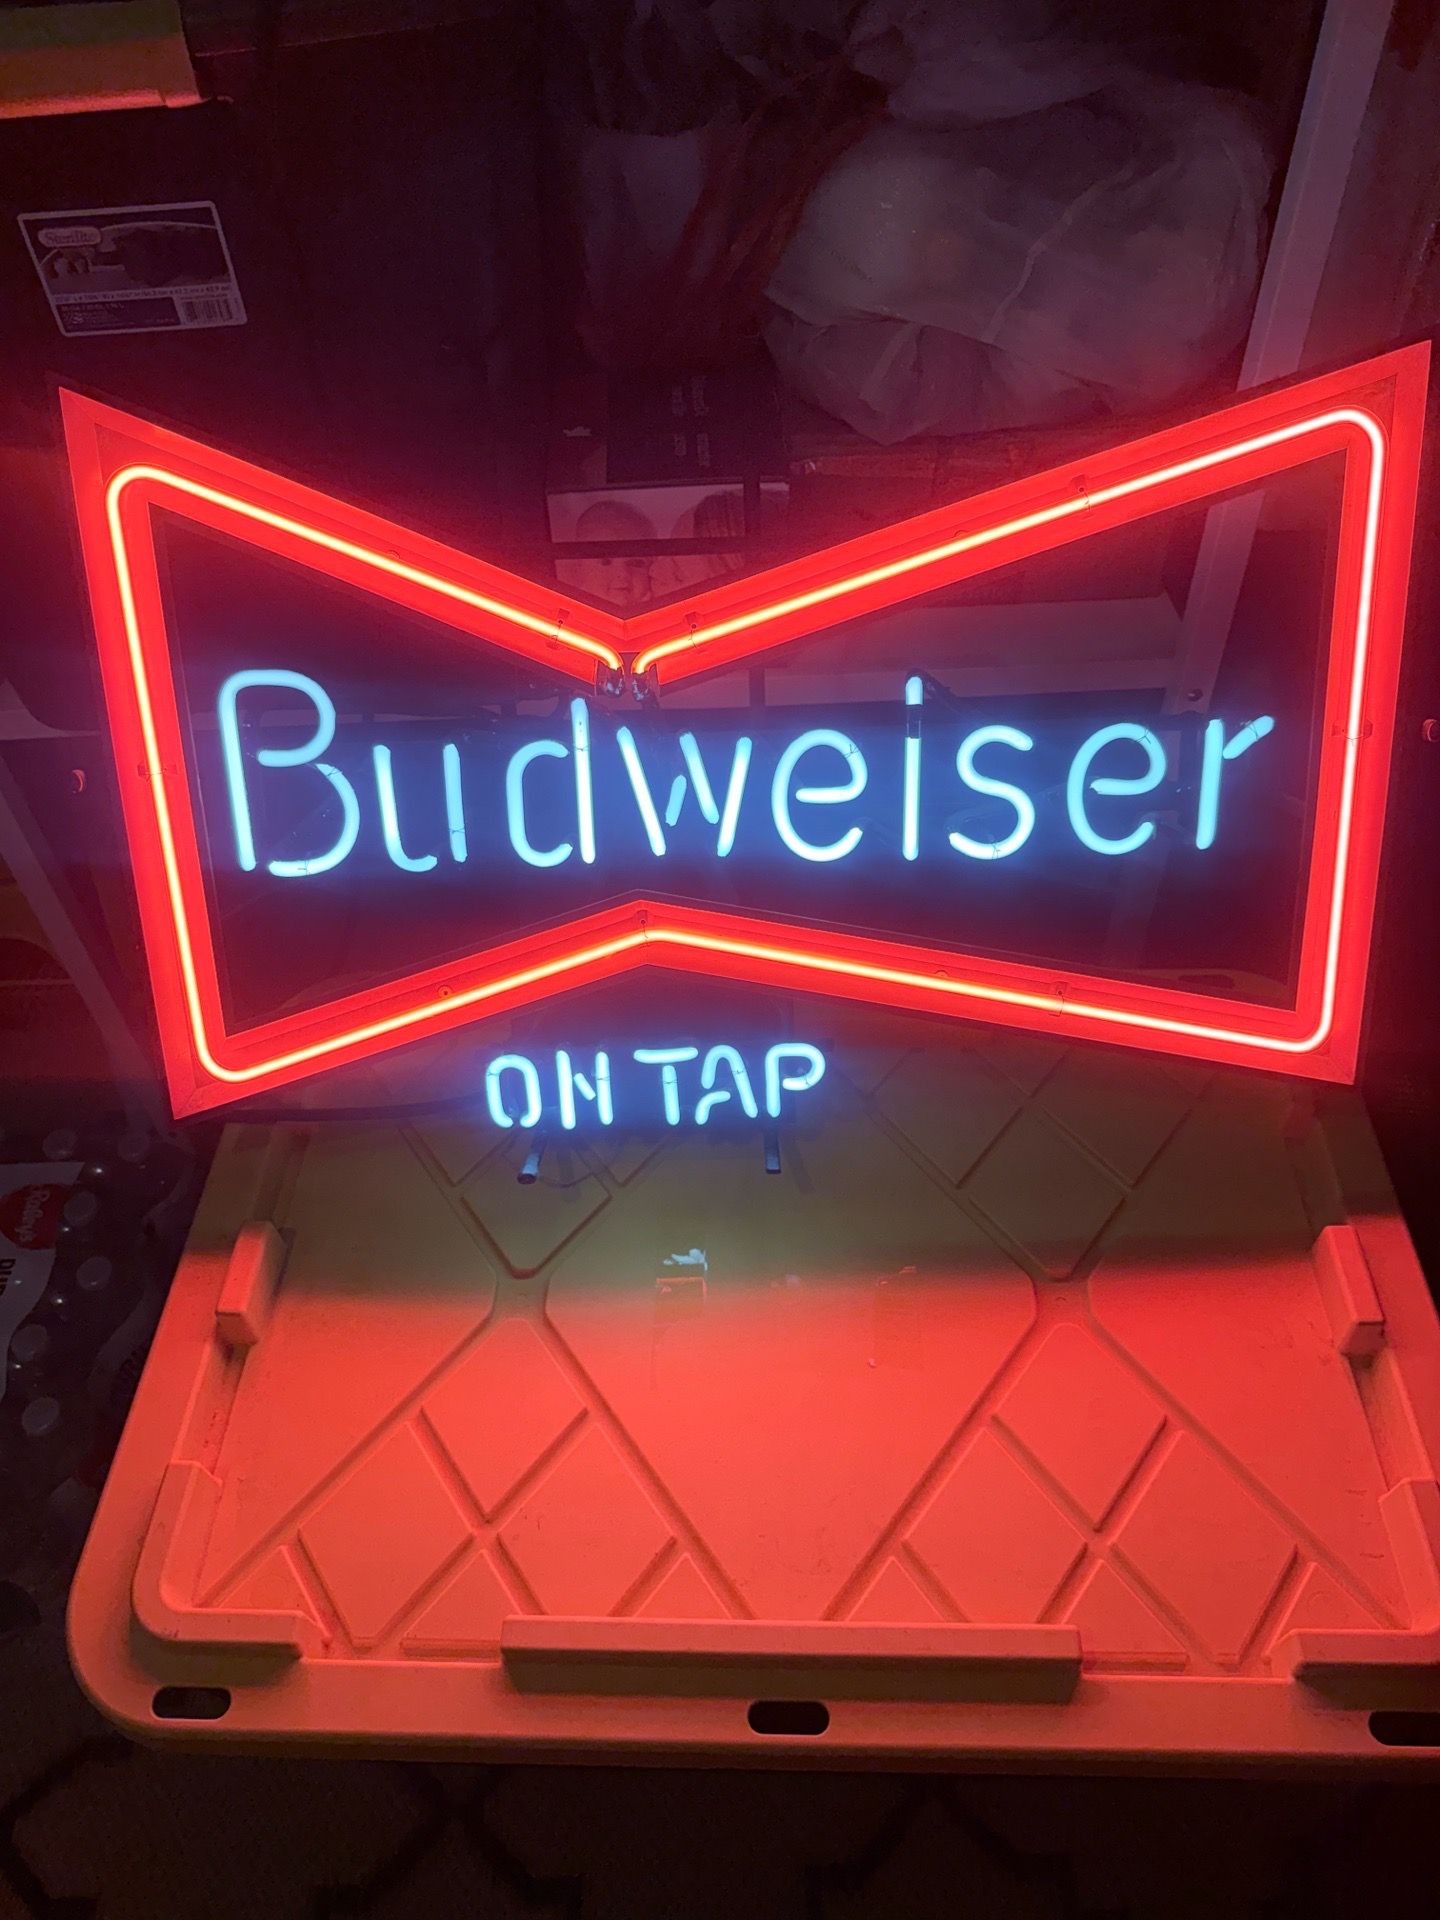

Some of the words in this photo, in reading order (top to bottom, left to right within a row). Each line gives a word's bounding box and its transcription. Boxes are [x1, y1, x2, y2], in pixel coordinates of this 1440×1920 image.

[218, 669, 1275, 878] Budweiser
[485, 1050, 614, 1130] ON
[633, 1042, 826, 1126] TAP
